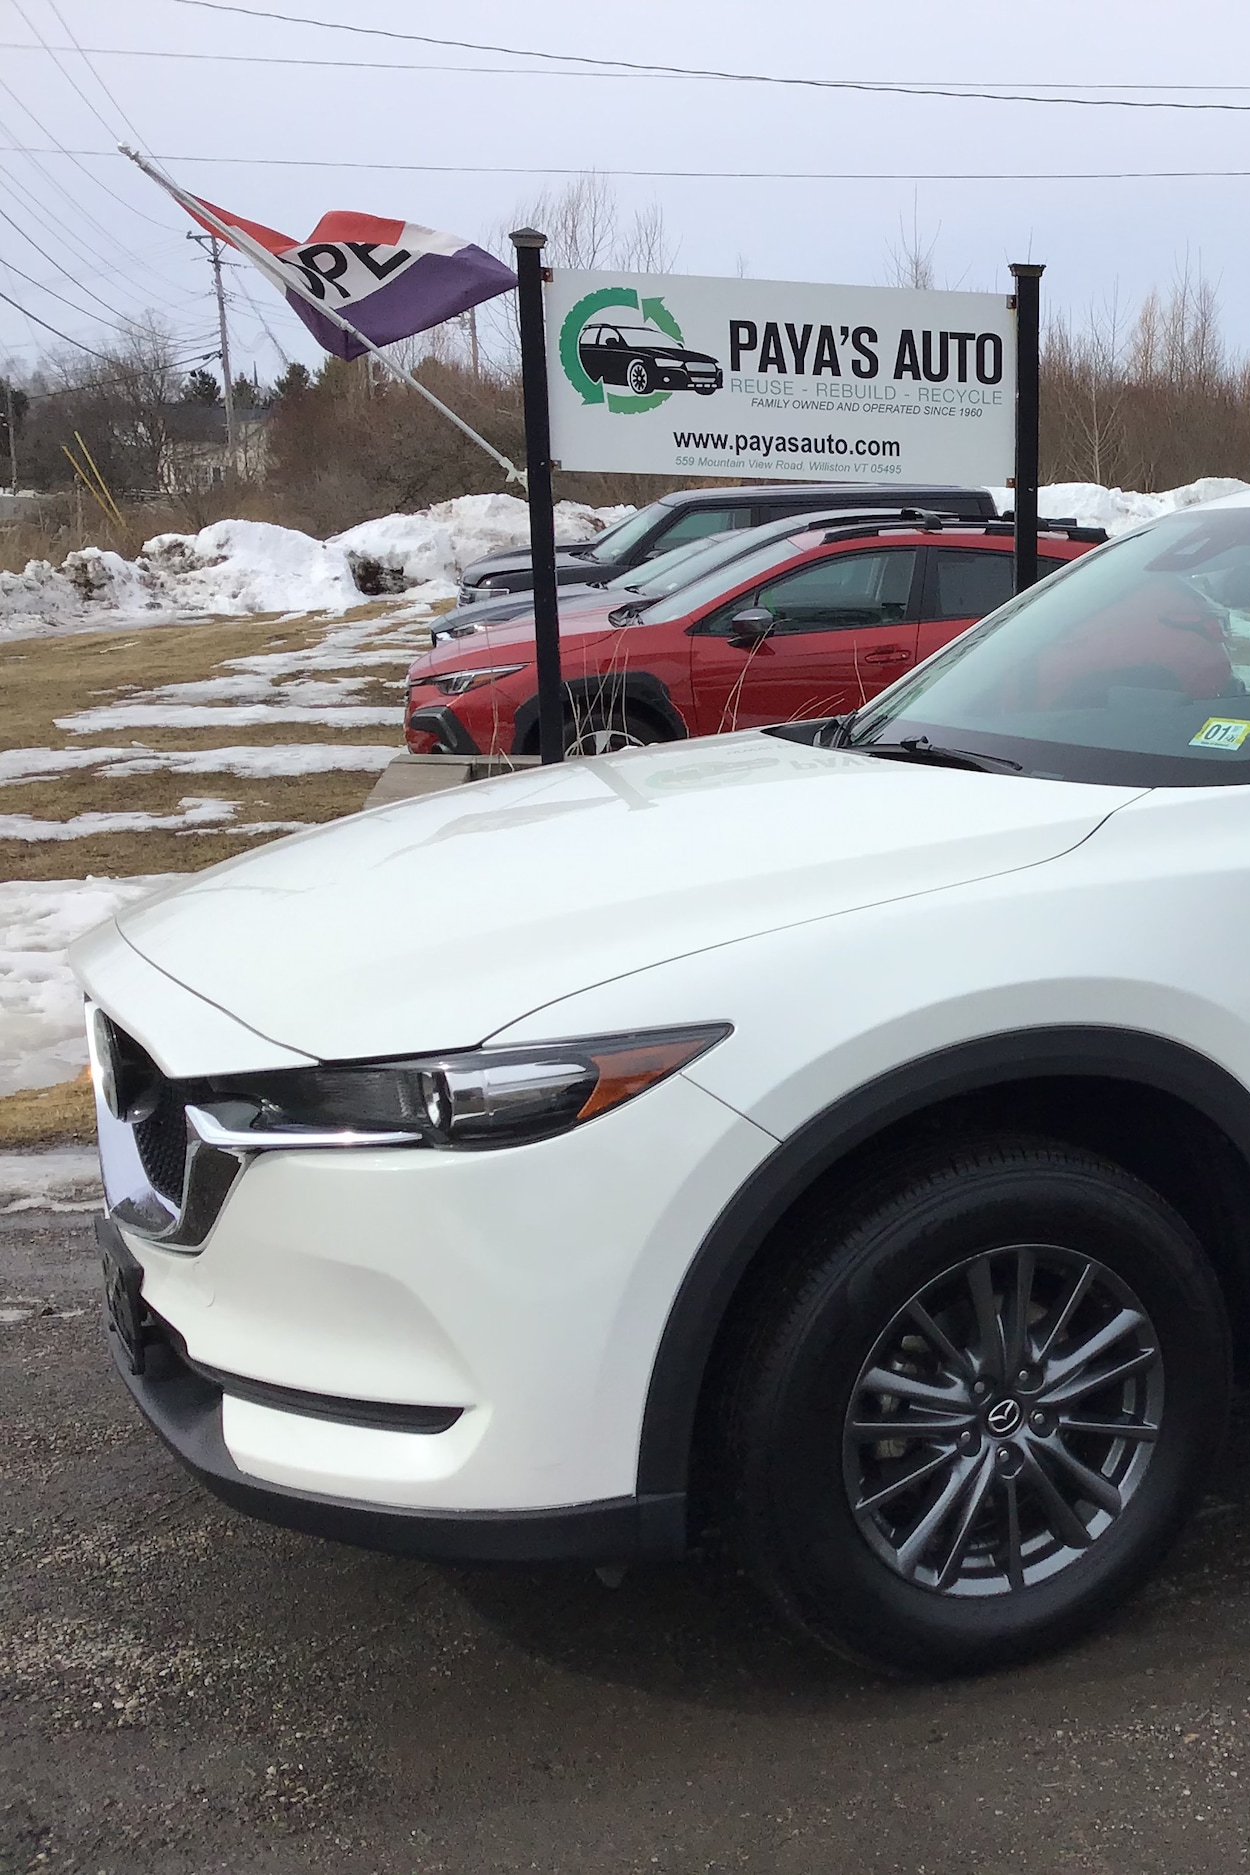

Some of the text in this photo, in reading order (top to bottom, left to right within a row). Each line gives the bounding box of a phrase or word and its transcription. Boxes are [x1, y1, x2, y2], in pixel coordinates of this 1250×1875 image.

[277, 242, 412, 300] OPE
[730, 320, 1003, 385] PAYA'S AUTO
[731, 378, 794, 396] REUSE
[816, 382, 896, 400] REBUILD
[918, 387, 1003, 405] RECYCLE
[751, 398, 983, 418] FAMILY OWNED AND OPERATED SINCE 1960
[673, 432, 900, 457] www.payasauto.com
[675, 456, 902, 475] 559 Mountain View Road, Williston VT 05495
[1204, 724, 1232, 741] 01
